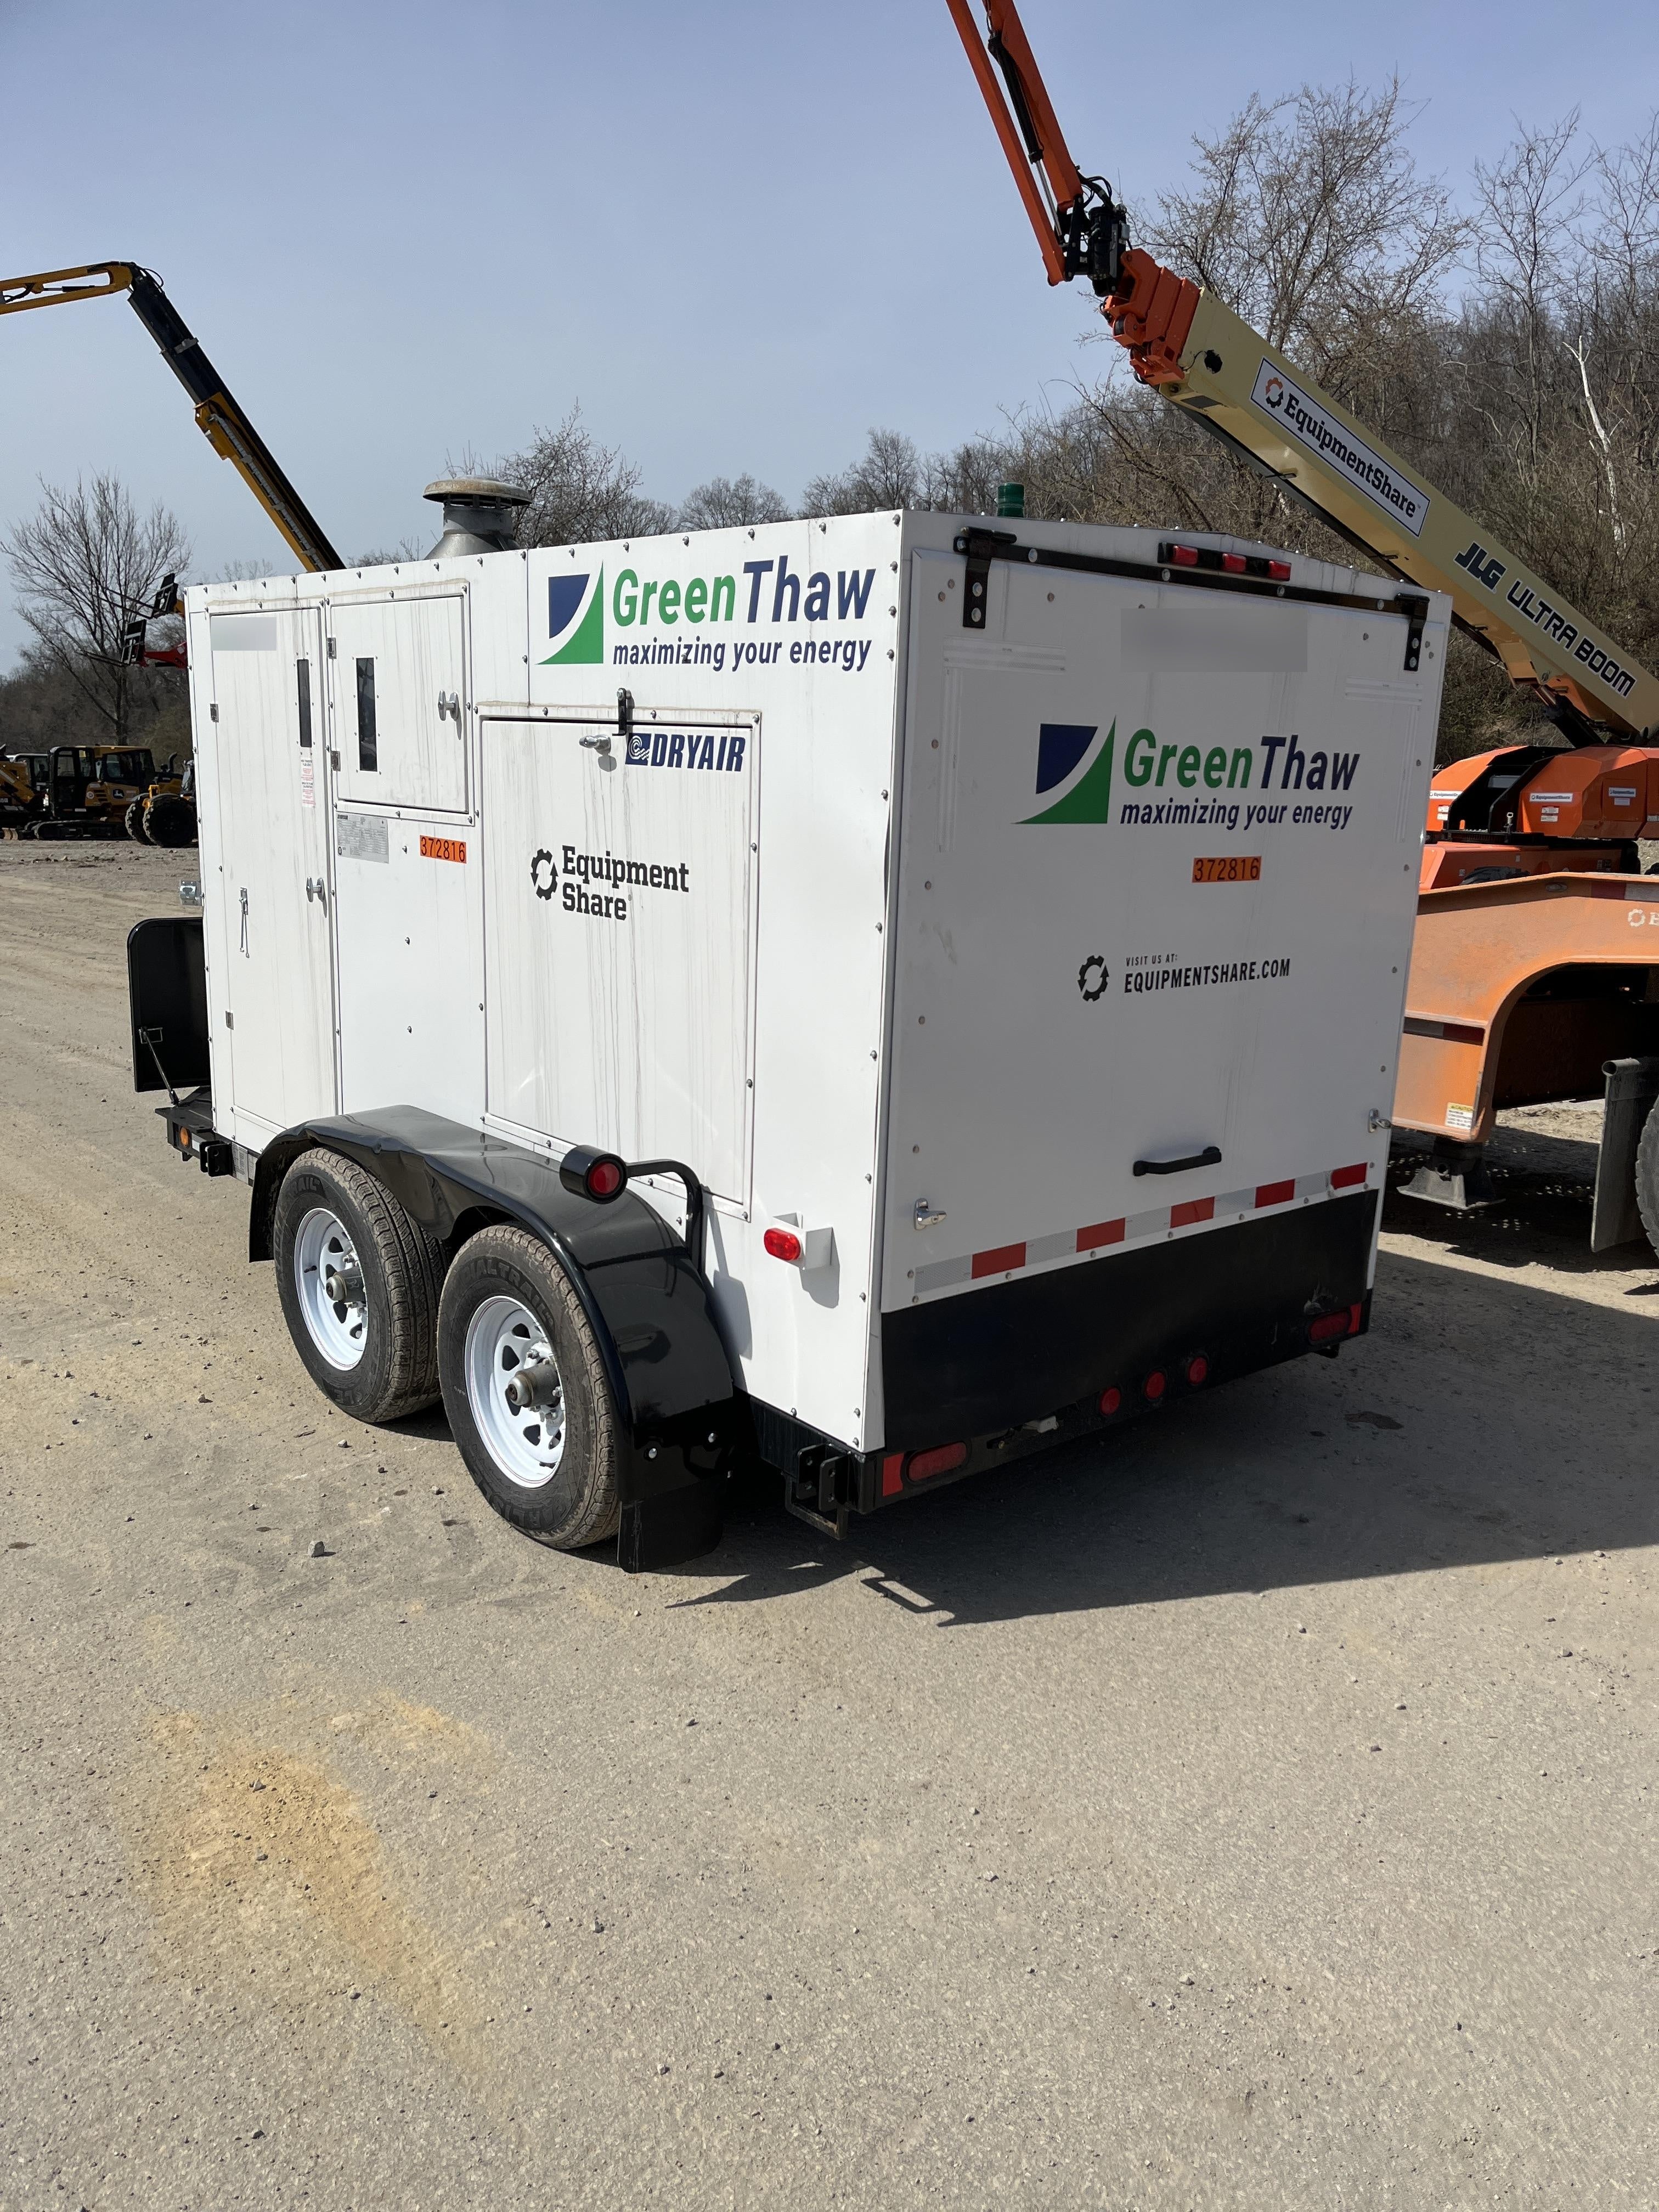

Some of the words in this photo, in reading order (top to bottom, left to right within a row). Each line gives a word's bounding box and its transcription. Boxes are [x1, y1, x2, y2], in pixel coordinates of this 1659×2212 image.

[1283, 392, 1416, 518] EquipmentShare
[1454, 541, 1508, 591] JLG
[1506, 579, 1579, 651] ULTRA
[1573, 637, 1637, 698] BOOM
[613, 635, 726, 672] maximizing
[732, 641, 782, 672] your
[789, 639, 872, 672] energy
[651, 733, 746, 772] DRYAIR
[1120, 797, 1240, 831] maximizing
[1243, 804, 1288, 831] your
[1292, 805, 1353, 830] energy
[421, 836, 465, 862] 372816
[562, 844, 689, 893] Equipment
[1194, 857, 1260, 882] 372816
[562, 881, 627, 921] Share
[1124, 958, 1290, 993] EQUIPMENTSHARE.COM
[1125, 955, 1148, 967] VISIT
[1152, 955, 1162, 964] US
[1165, 953, 1178, 963] AT:
